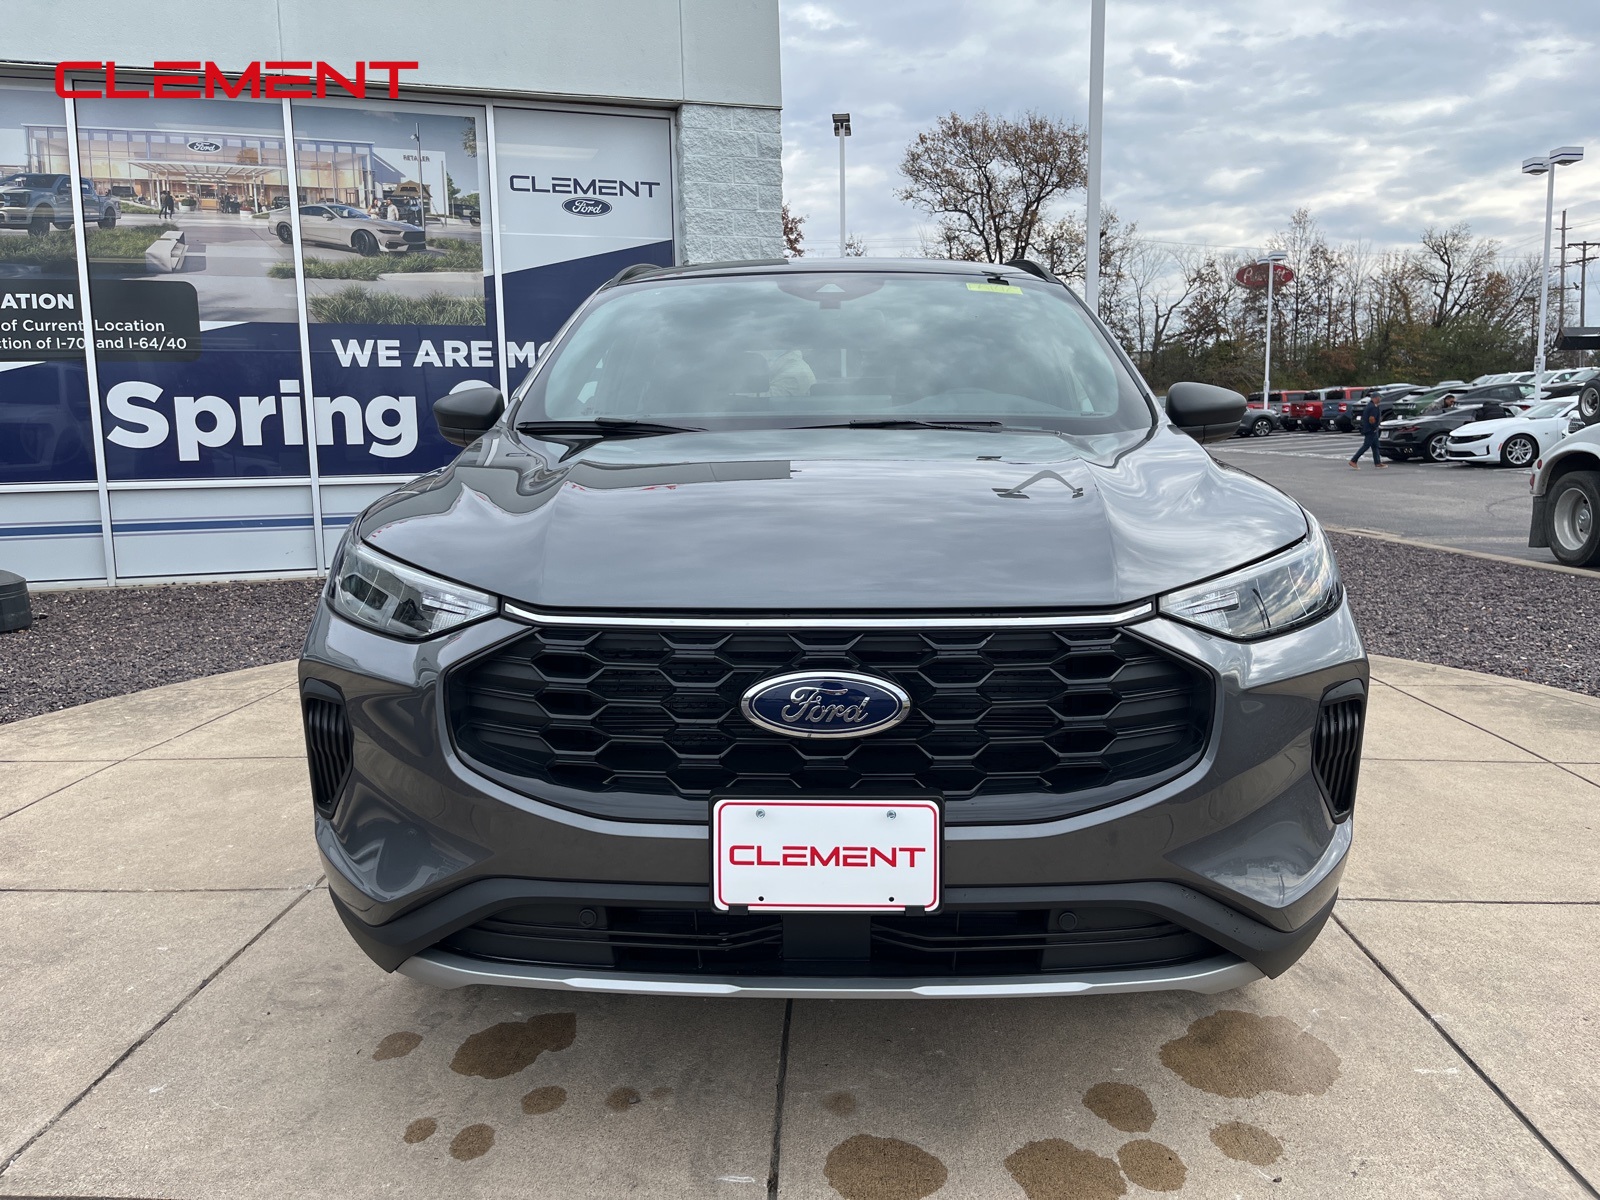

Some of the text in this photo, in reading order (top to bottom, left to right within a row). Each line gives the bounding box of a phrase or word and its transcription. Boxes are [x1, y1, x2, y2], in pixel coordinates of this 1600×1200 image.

[510, 175, 660, 198] CLEMENT
[1, 293, 75, 310] ATION
[1, 319, 165, 332] of Current Location
[0, 336, 187, 351] tion of I-70 and I-64/40
[331, 339, 402, 368] WE
[413, 340, 494, 368] ARE
[106, 379, 419, 462] Spring
[781, 686, 870, 723] Ford
[729, 845, 926, 868] CLEMENT
